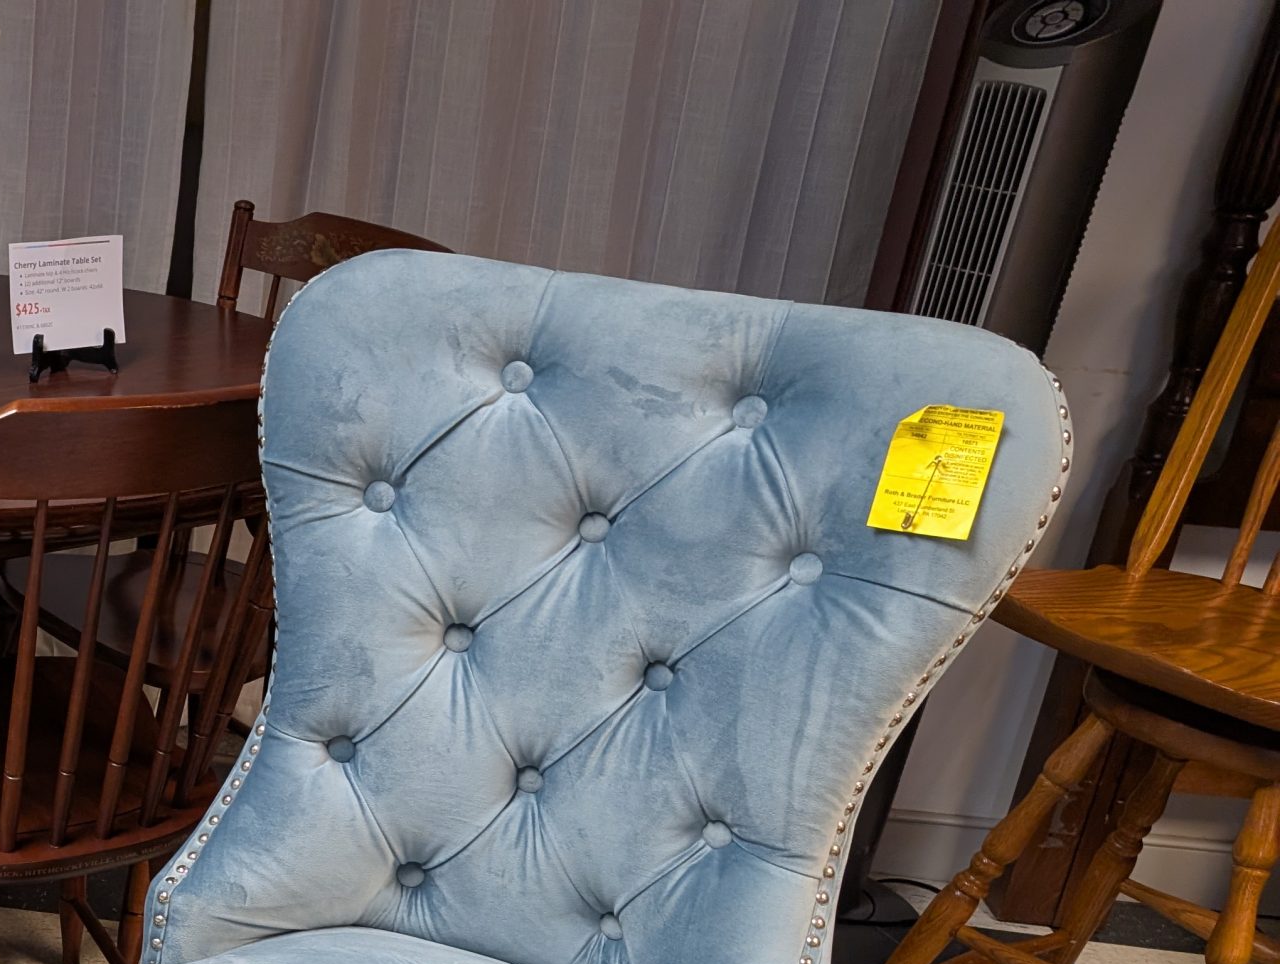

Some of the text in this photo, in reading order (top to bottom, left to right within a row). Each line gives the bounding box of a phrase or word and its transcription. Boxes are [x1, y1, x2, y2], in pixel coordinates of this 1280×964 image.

[14, 256, 102, 270] Cherry Laminate Table Set
[16, 302, 40, 316] $425
[919, 418, 962, 428] ECOND-HAND
[964, 423, 996, 432] MATERIAL
[950, 446, 985, 456] CONTENTS
[944, 452, 987, 463] DISINFECTED
[928, 495, 956, 505] Furniture
[957, 498, 970, 506] LLC
[917, 504, 949, 513] umberland
